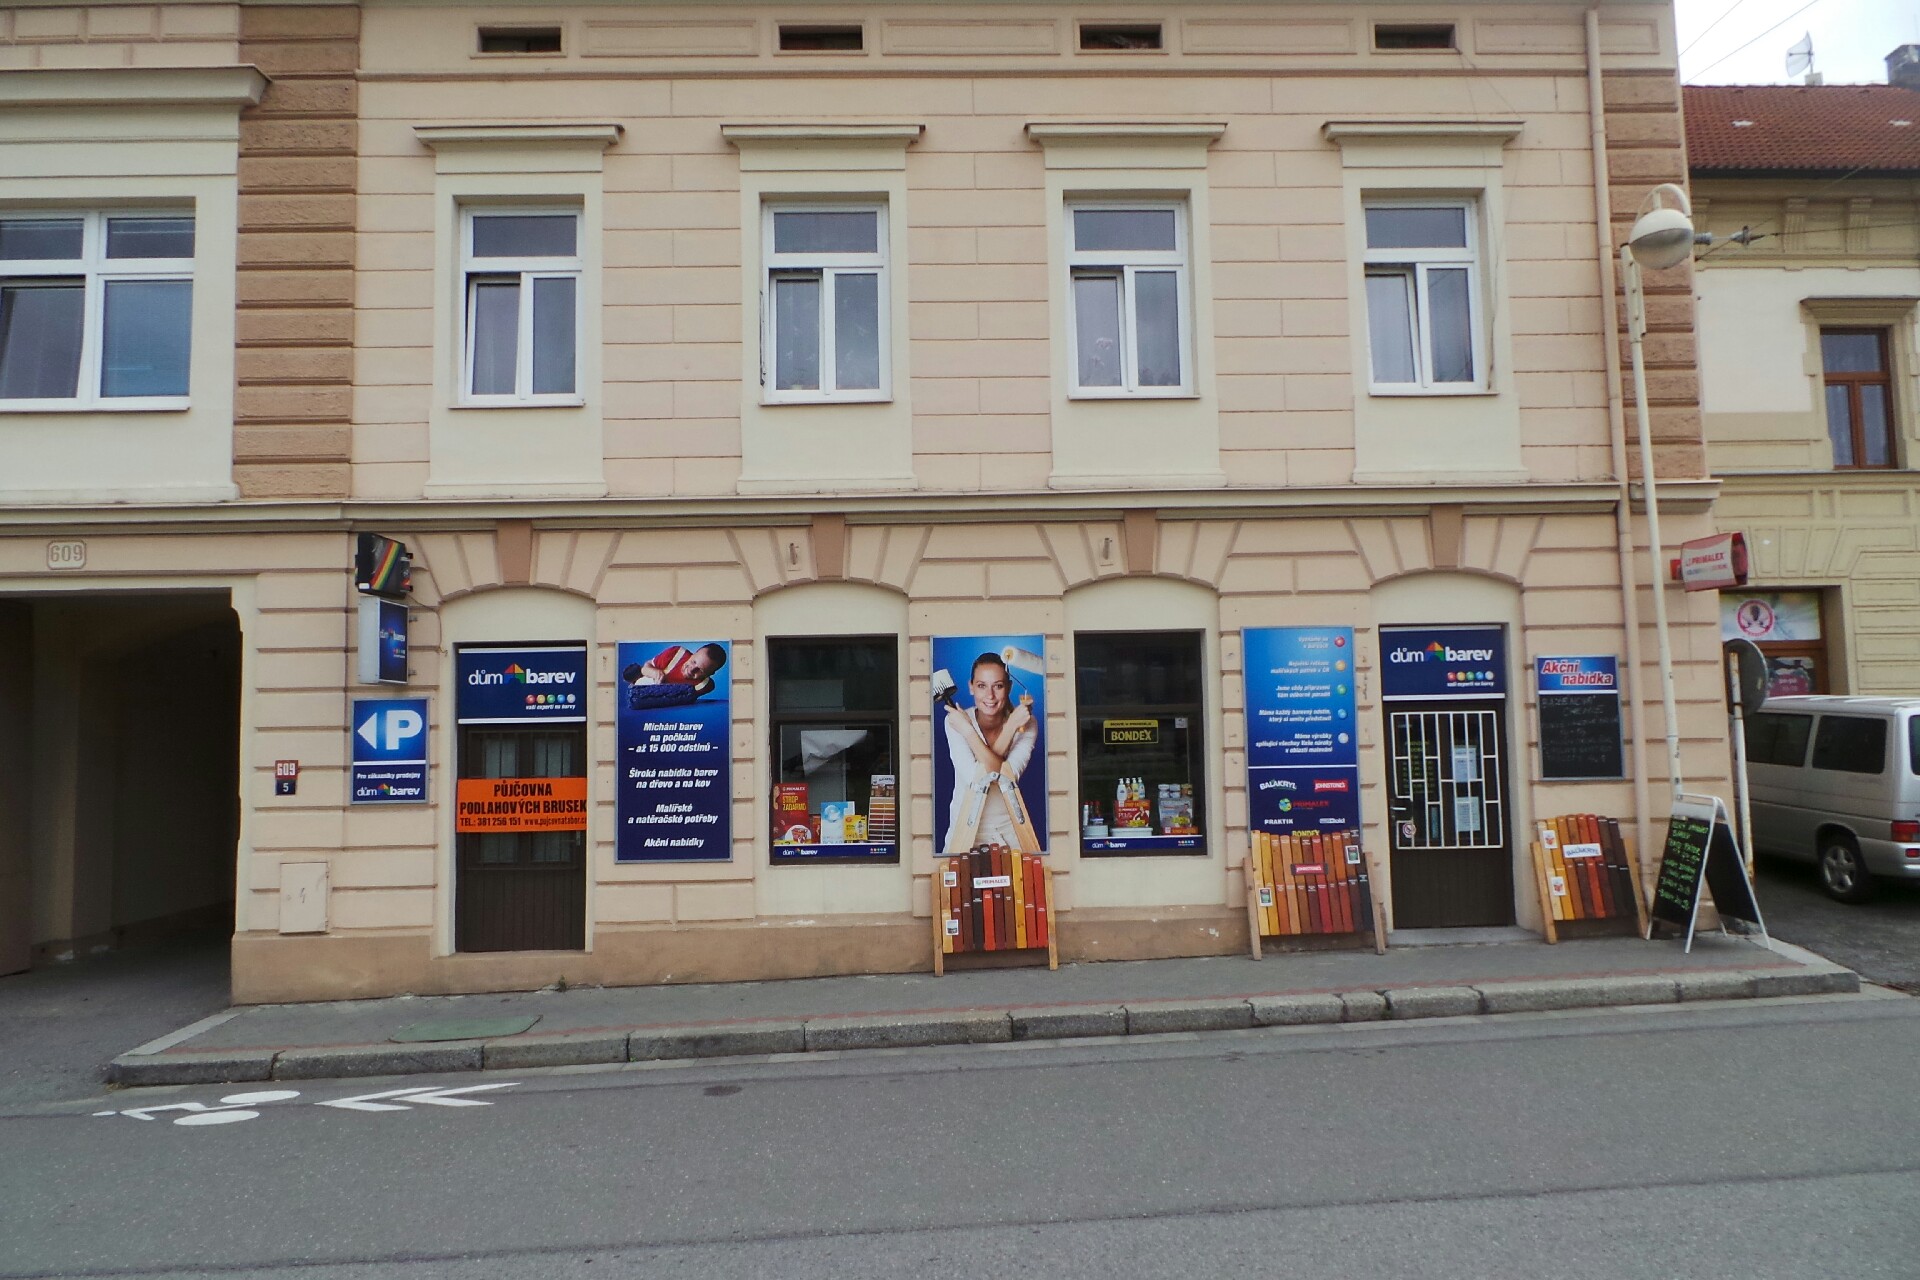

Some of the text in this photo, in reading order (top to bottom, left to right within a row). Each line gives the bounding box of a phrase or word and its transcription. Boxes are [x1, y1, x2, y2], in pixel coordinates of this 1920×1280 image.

[51, 544, 83, 562] 609
[1390, 646, 1493, 663] dům barev
[1541, 660, 1580, 674] Akční
[468, 669, 576, 685] dům barev
[1560, 671, 1613, 685] nabídka
[386, 709, 423, 750] P
[643, 722, 704, 732] Míchání barev
[649, 732, 697, 743] na počkání
[1111, 730, 1152, 741] BONDEX
[635, 743, 647, 753] až
[649, 743, 659, 752] 15
[660, 743, 677, 752] 000
[678, 741, 711, 752] odstínů
[277, 762, 296, 776] 609
[628, 767, 719, 778] Široká nabídka barev
[282, 783, 289, 792] 5
[494, 780, 553, 797] PŮJČOVNA
[636, 779, 711, 789] na dřevo a na kov
[1259, 779, 1297, 790] BALAKRYL
[356, 786, 421, 796] dům barev
[460, 799, 587, 815] PODLAHOVÝCH BRUSEK
[655, 803, 693, 813] Malířské
[477, 817, 491, 827] 381
[492, 817, 507, 826] 256
[509, 817, 521, 826] 151
[627, 813, 719, 825] a natěračské potřeby
[643, 837, 704, 848] Akční nabídky
